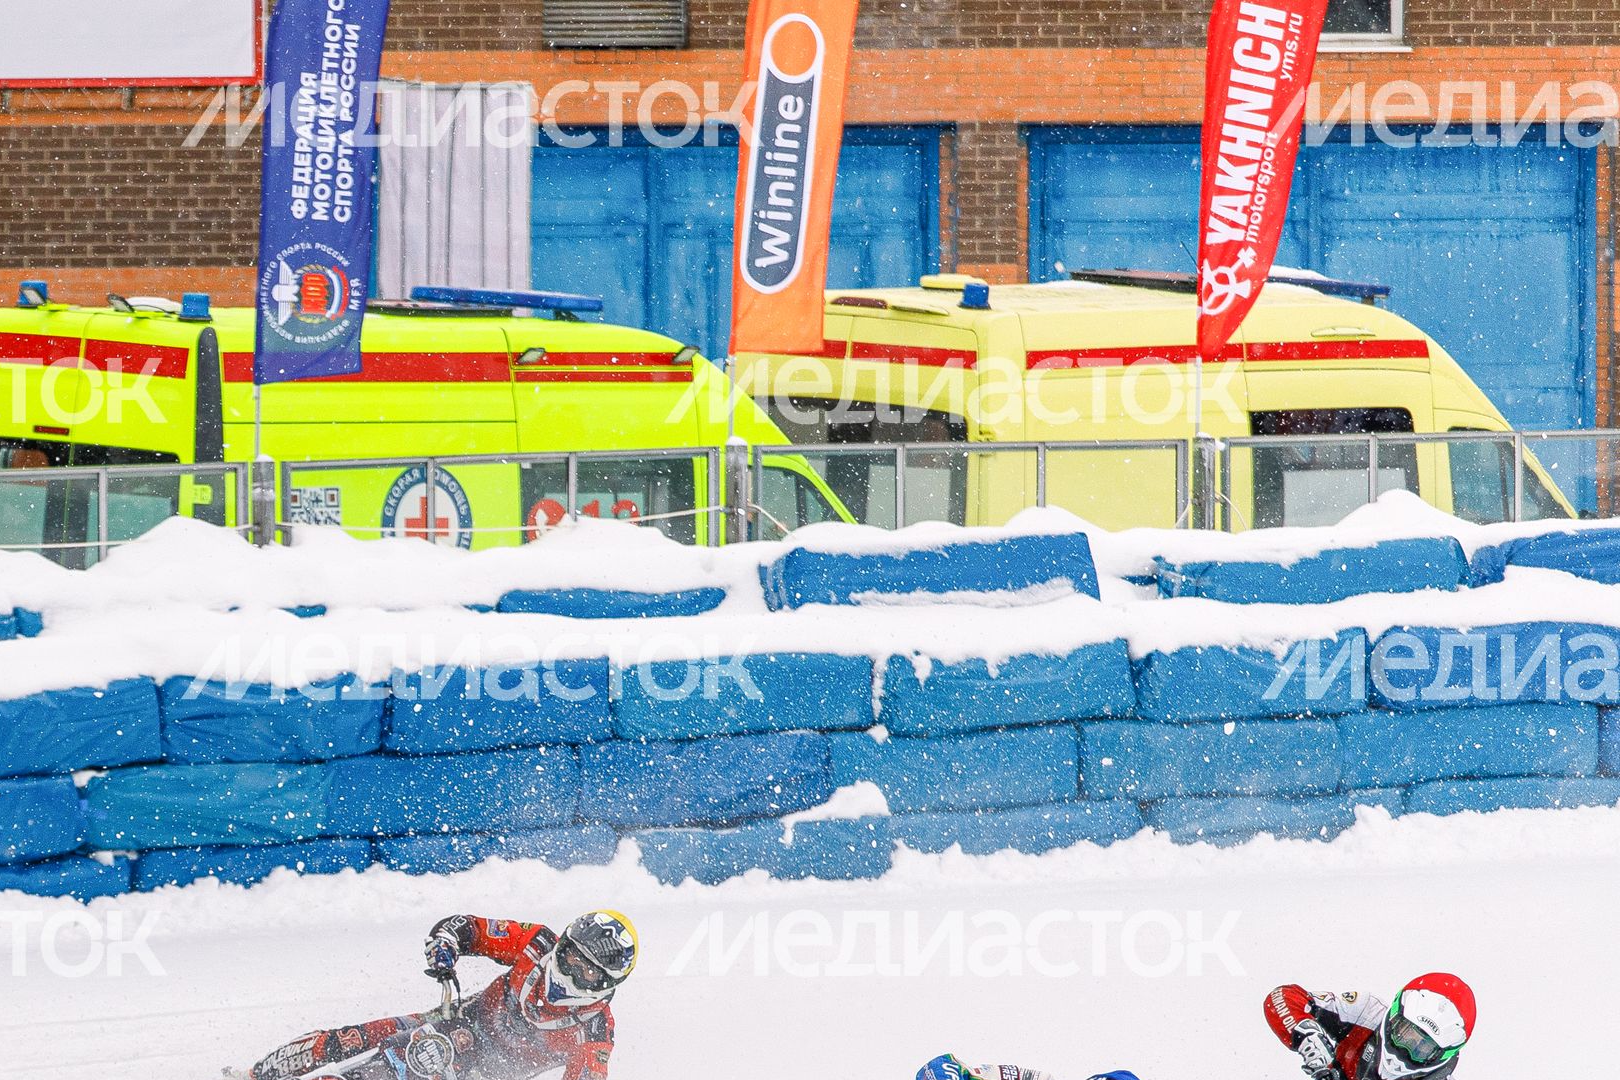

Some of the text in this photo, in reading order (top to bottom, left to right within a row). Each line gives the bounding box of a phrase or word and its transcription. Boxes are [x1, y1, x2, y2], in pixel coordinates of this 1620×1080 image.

[311, 0, 345, 221] МОТОЦИКЛЕТНОГО
[1279, 12, 1303, 82] yms.ru
[290, 72, 318, 219] ФЕДЕРАЦИЯ
[333, 23, 361, 223] СПОРТА РОССИИ
[1205, 1, 1287, 245] YAKHNICH
[1245, 130, 1278, 243] motorsport
[433, 468, 469, 516] ОМОЩЬ
[1418, 1015, 1441, 1034] SHOEI
